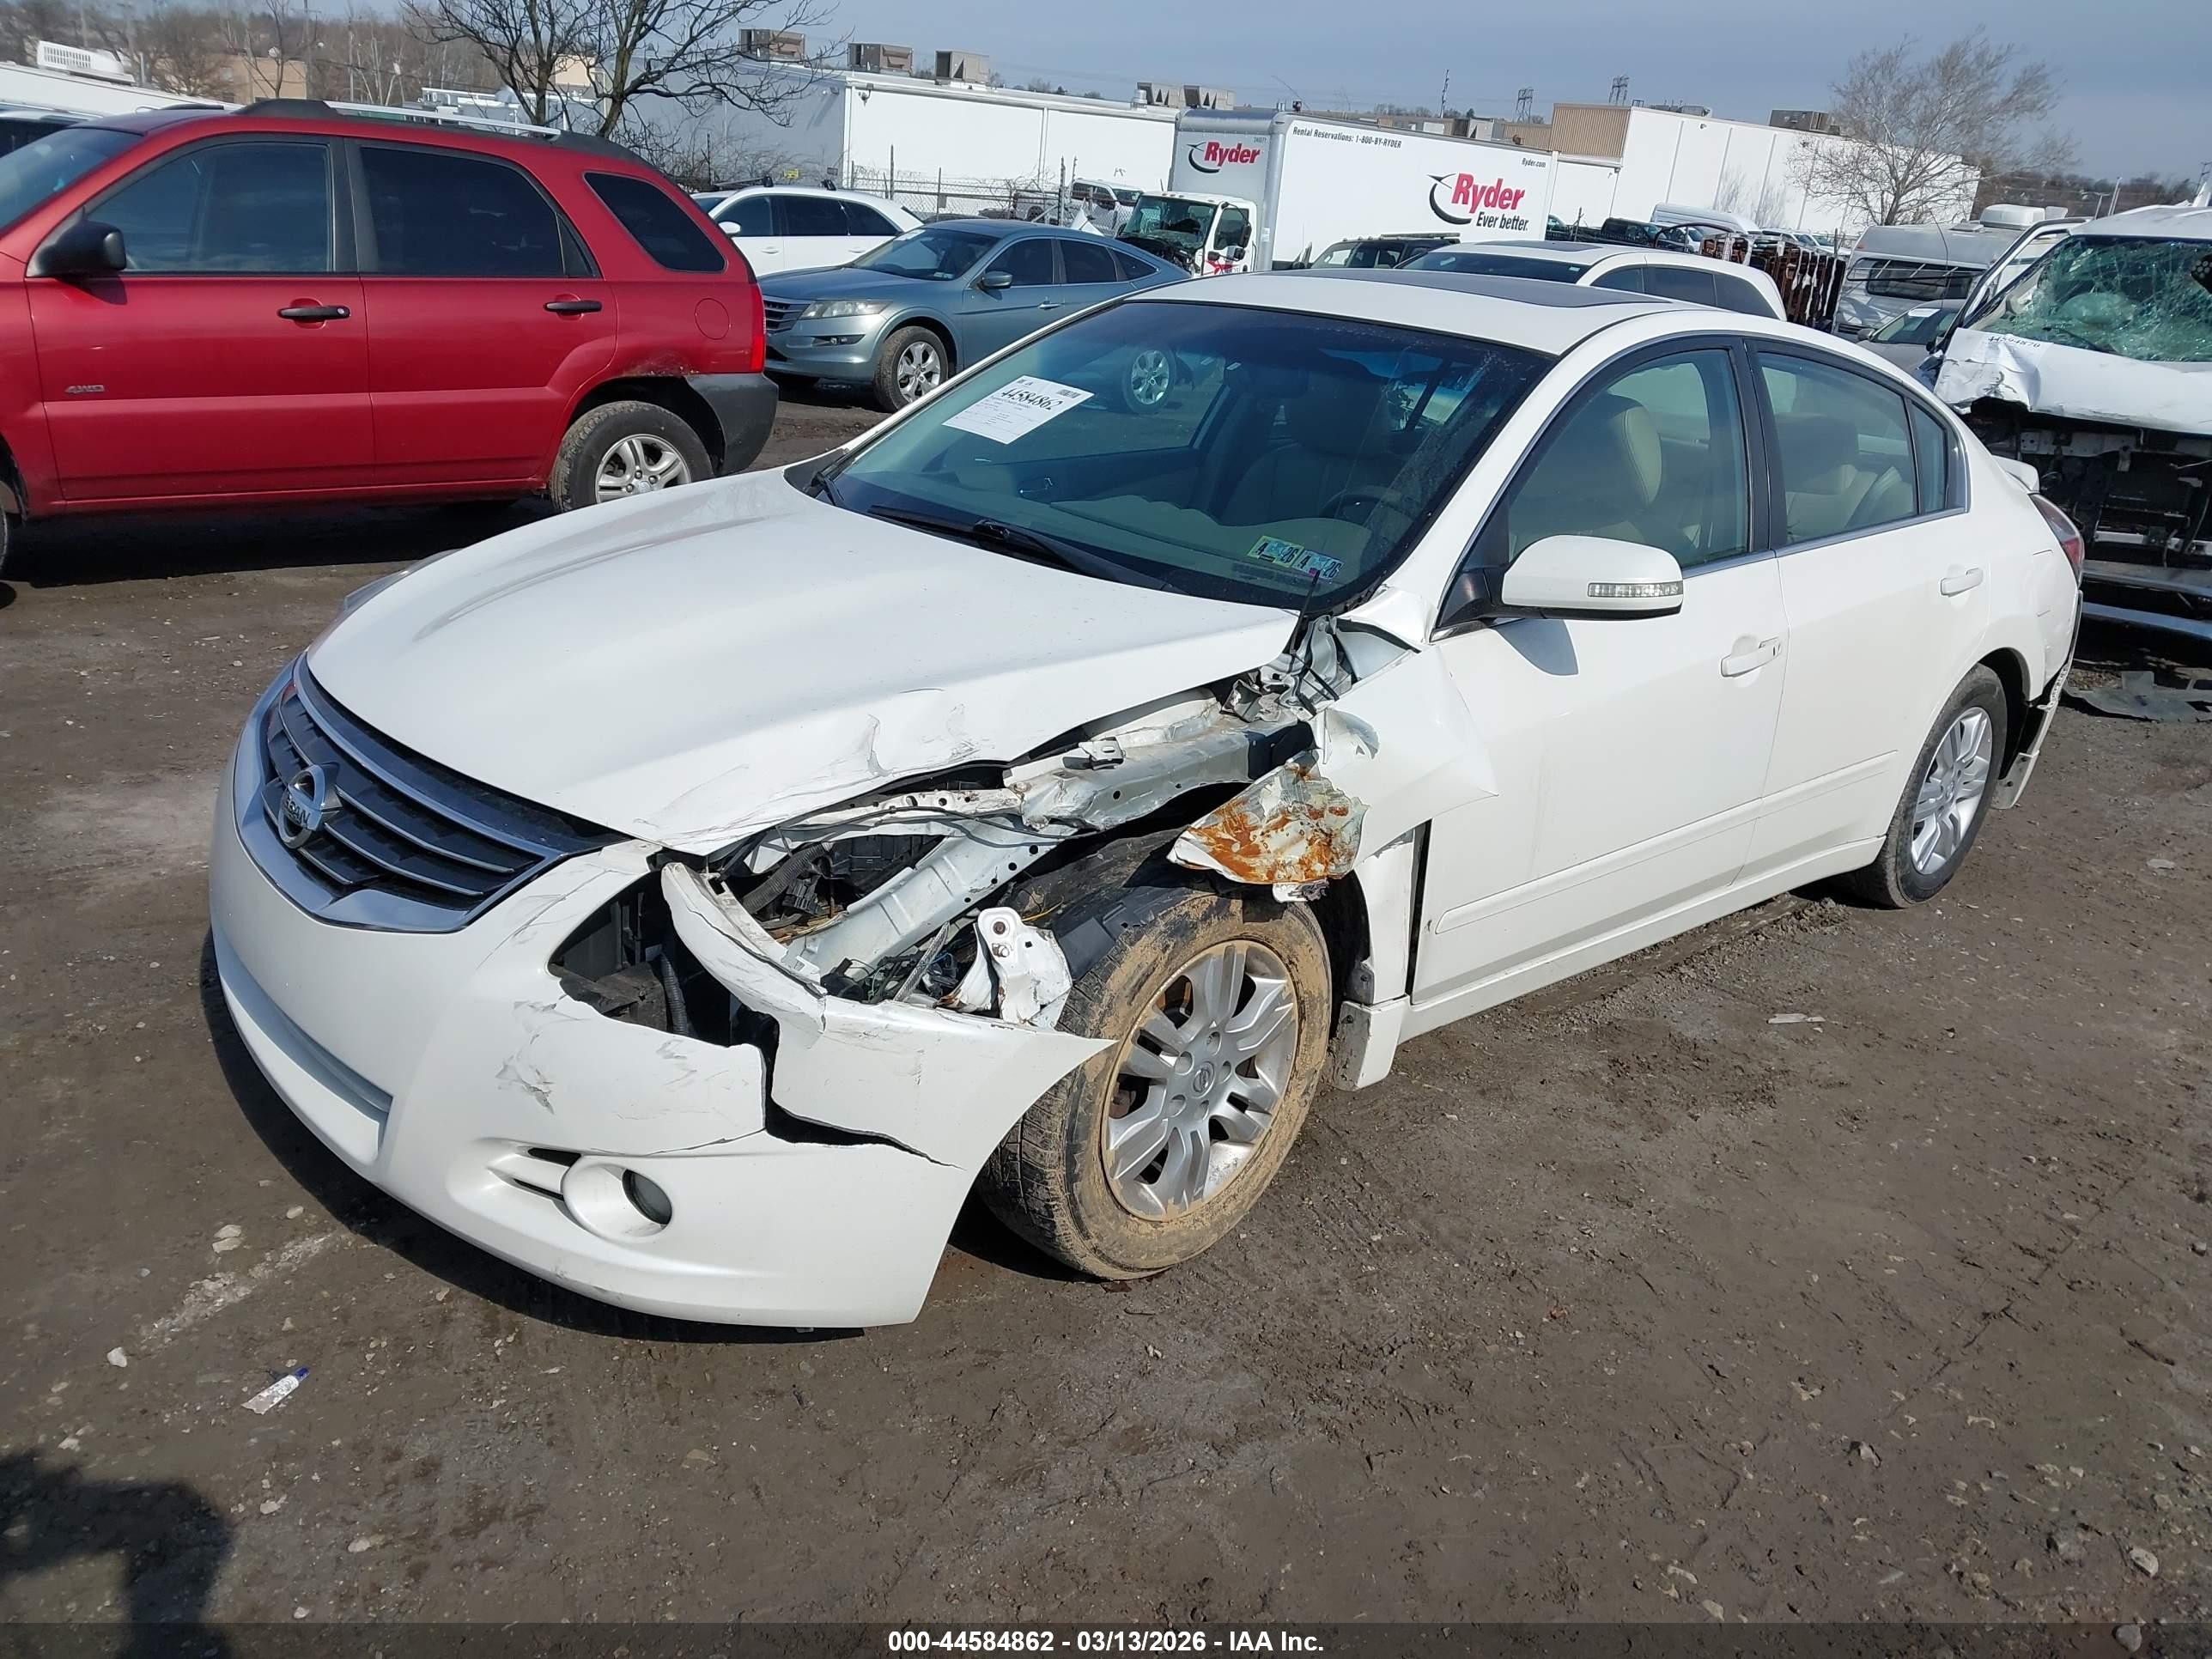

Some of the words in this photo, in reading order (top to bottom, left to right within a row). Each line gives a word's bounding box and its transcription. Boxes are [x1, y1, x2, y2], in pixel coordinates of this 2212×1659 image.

[1292, 126, 1312, 137] Rental
[1314, 129, 1354, 142] Reservations:
[1356, 135, 1402, 149] 1-800-BY-RYDER
[1204, 141, 1261, 167] Ryder
[1521, 157, 1547, 168] Ryder.com
[1451, 173, 1526, 214] Ryder
[1476, 211, 1500, 228] Ever
[1499, 213, 1530, 232] better.
[1001, 387, 1064, 410] 44584862
[1257, 542, 1268, 556] 4
[1280, 546, 1299, 563] 26
[1300, 555, 1311, 568] 4
[1323, 561, 1341, 579] 26
